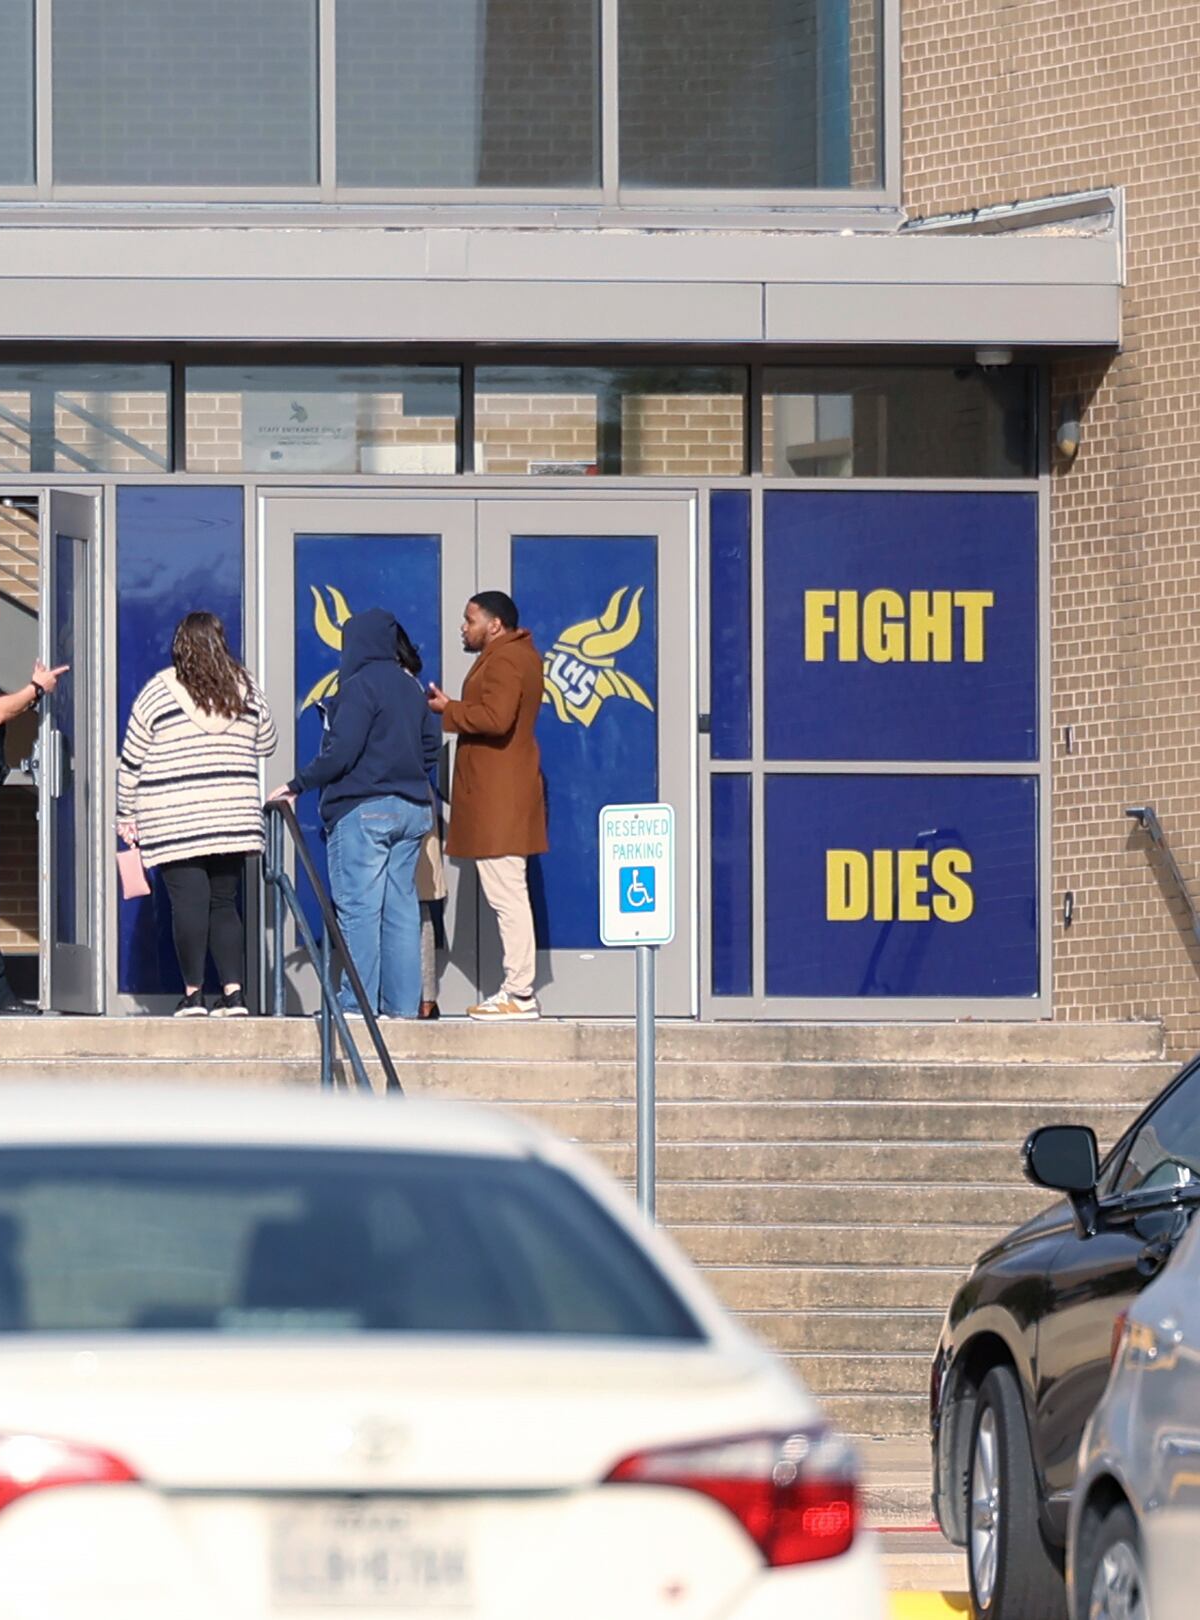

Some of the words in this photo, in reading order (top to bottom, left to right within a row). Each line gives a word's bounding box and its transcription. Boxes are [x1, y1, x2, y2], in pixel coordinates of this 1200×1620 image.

[804, 588, 994, 664] FIGHT
[550, 653, 596, 706] LHS
[606, 819, 669, 837] RESERVED
[612, 842, 663, 860] PARKING
[826, 849, 974, 923] DIES
